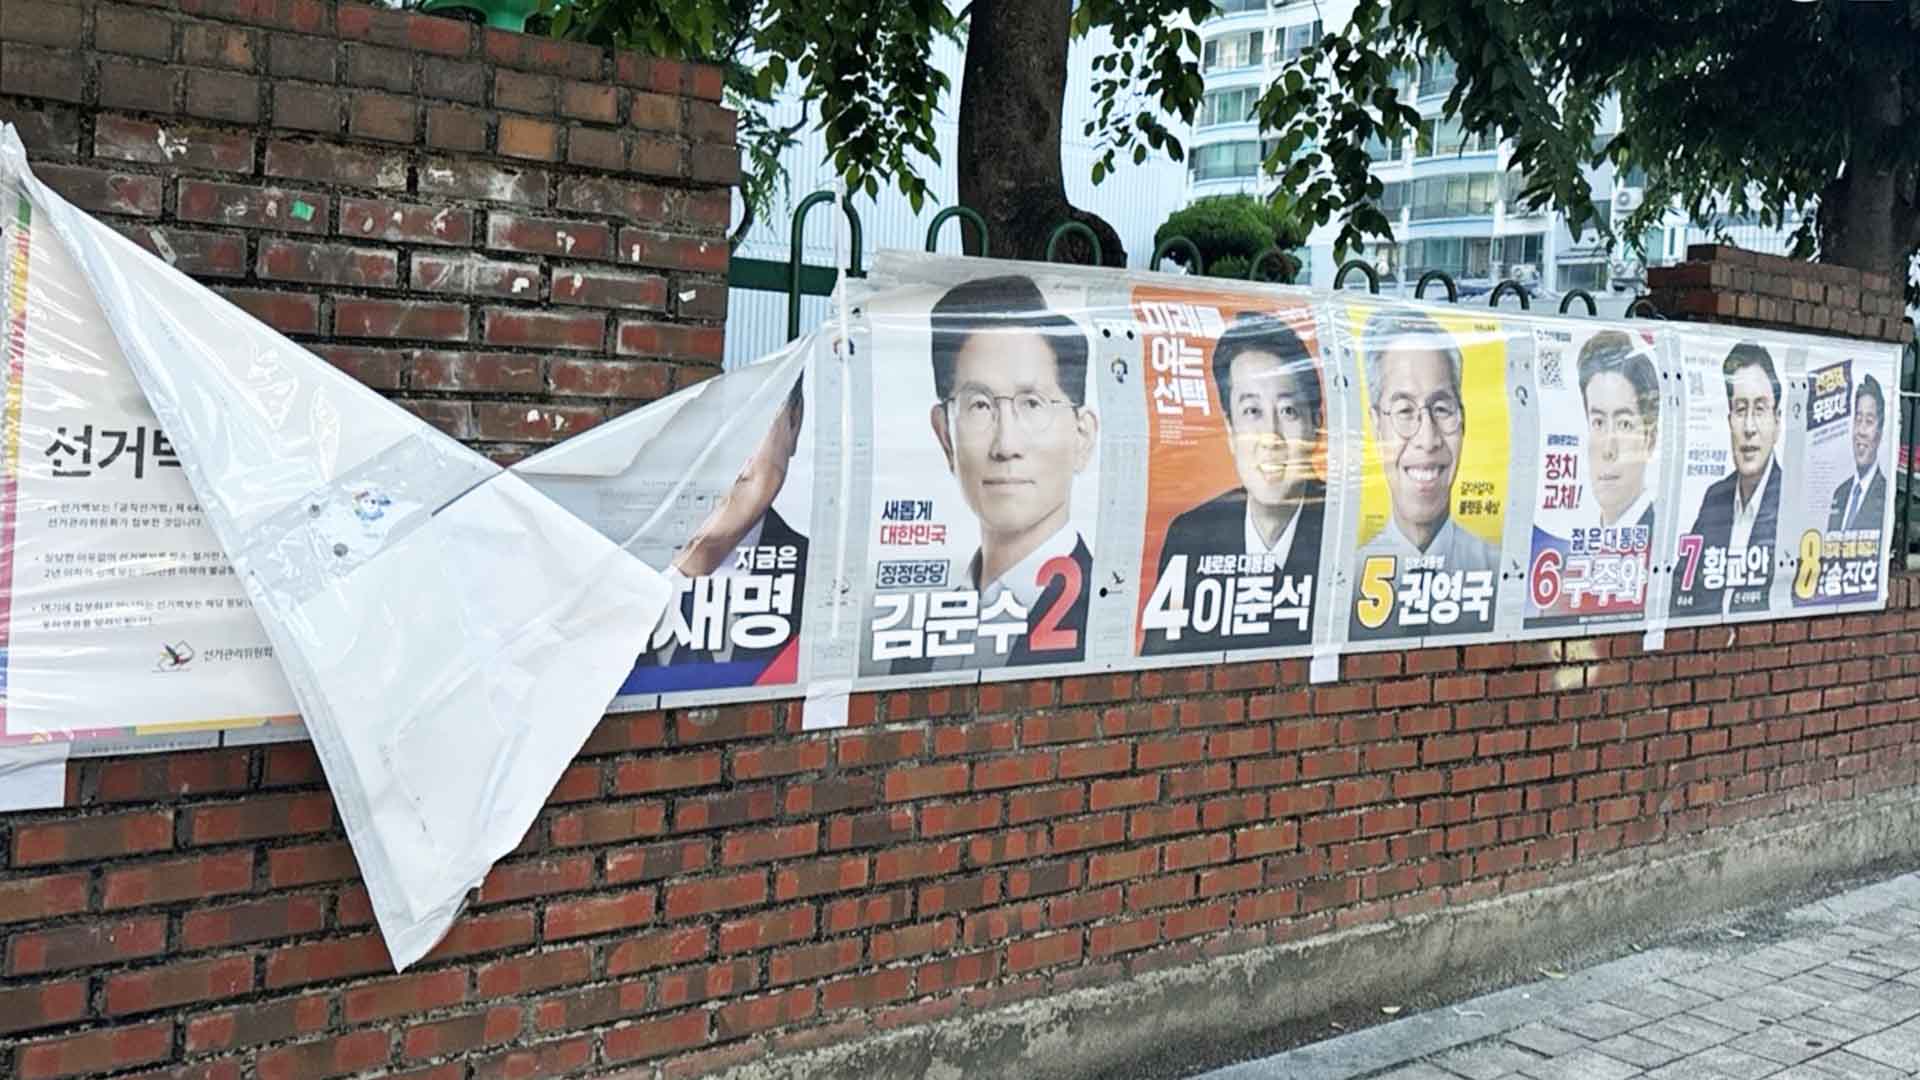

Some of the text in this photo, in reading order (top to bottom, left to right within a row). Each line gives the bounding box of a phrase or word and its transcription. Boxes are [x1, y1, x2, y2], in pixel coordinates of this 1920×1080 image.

[1139, 301, 1225, 339] 미래
[1151, 337, 1204, 376] 여는
[1153, 376, 1211, 416] 선택
[1545, 453, 1578, 480] 정치
[881, 500, 933, 521] 새롭게
[1542, 484, 1583, 510] 교체!
[879, 525, 947, 546] 대한민국
[735, 545, 798, 570] 지금은
[881, 563, 945, 586] 정정당당
[1197, 554, 1238, 575] 새로운
[1679, 535, 1703, 592] 7
[1703, 546, 1770, 590] 황교안
[1794, 529, 1822, 599] 8
[1825, 560, 1877, 597] 송진호
[1141, 554, 1313, 641] 4 이준석
[1356, 555, 1494, 630] 5 권영국
[1531, 548, 1649, 609] 6 구주와
[641, 574, 797, 655] 재명
[871, 555, 1083, 662] 김문수 2
[203, 645, 274, 662] 선거관리위원회
